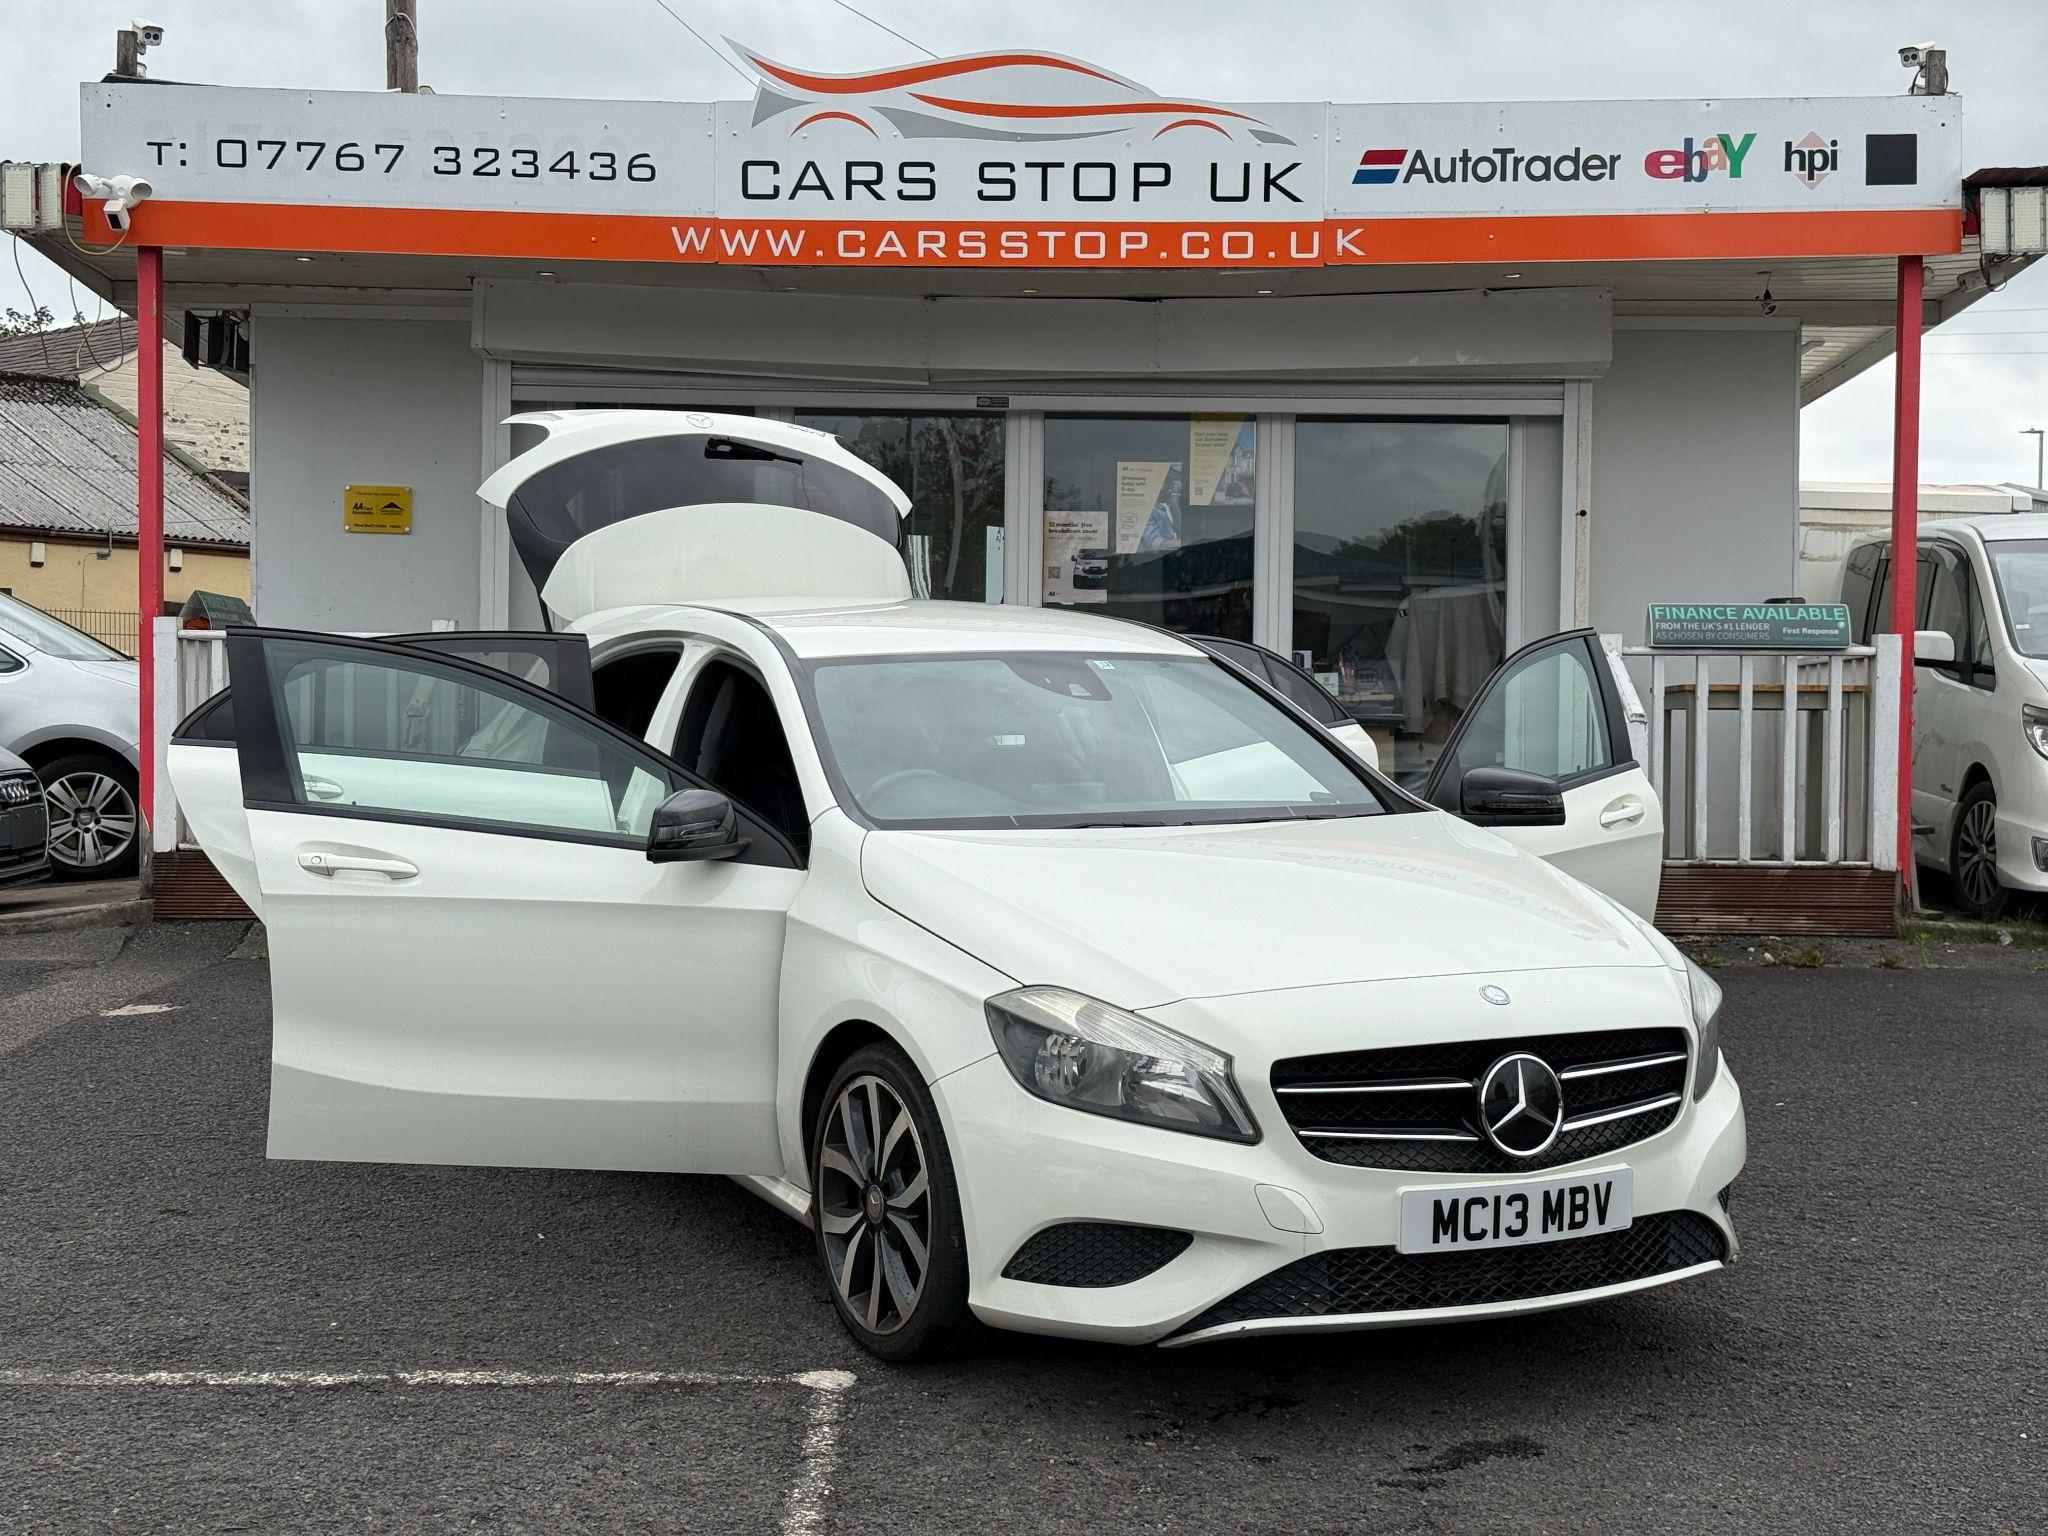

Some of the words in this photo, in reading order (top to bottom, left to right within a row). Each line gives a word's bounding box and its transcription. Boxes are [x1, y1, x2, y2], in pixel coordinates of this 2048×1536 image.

[147, 141, 187, 167] T:
[216, 139, 405, 173] 07767
[433, 146, 657, 182] 323436
[1402, 147, 1621, 184] AutoTrader
[1784, 138, 1838, 188] hpi
[741, 160, 937, 201] CARS
[977, 161, 1172, 202] STOP
[1209, 162, 1304, 203] UK
[671, 225, 1366, 260] WWW.CARSSTOP.CO.UK
[1654, 606, 1738, 620] FINANCE
[1742, 606, 1845, 621] AVAILABLE
[1656, 622, 1682, 631] FROM
[1683, 622, 1700, 631] THE
[1701, 622, 1722, 631] UK'S
[1723, 622, 1734, 631] #1
[1736, 622, 1770, 631] LENDER
[1782, 626, 1800, 635] First
[1802, 627, 1839, 637] Response
[1655, 631, 1667, 640] AS
[1668, 631, 1704, 640] CHOSEN
[1705, 631, 1716, 640] BY
[1717, 631, 1770, 641] CONSUMERS
[1432, 1193, 1529, 1244] MC13
[1542, 1181, 1613, 1234] MBV
